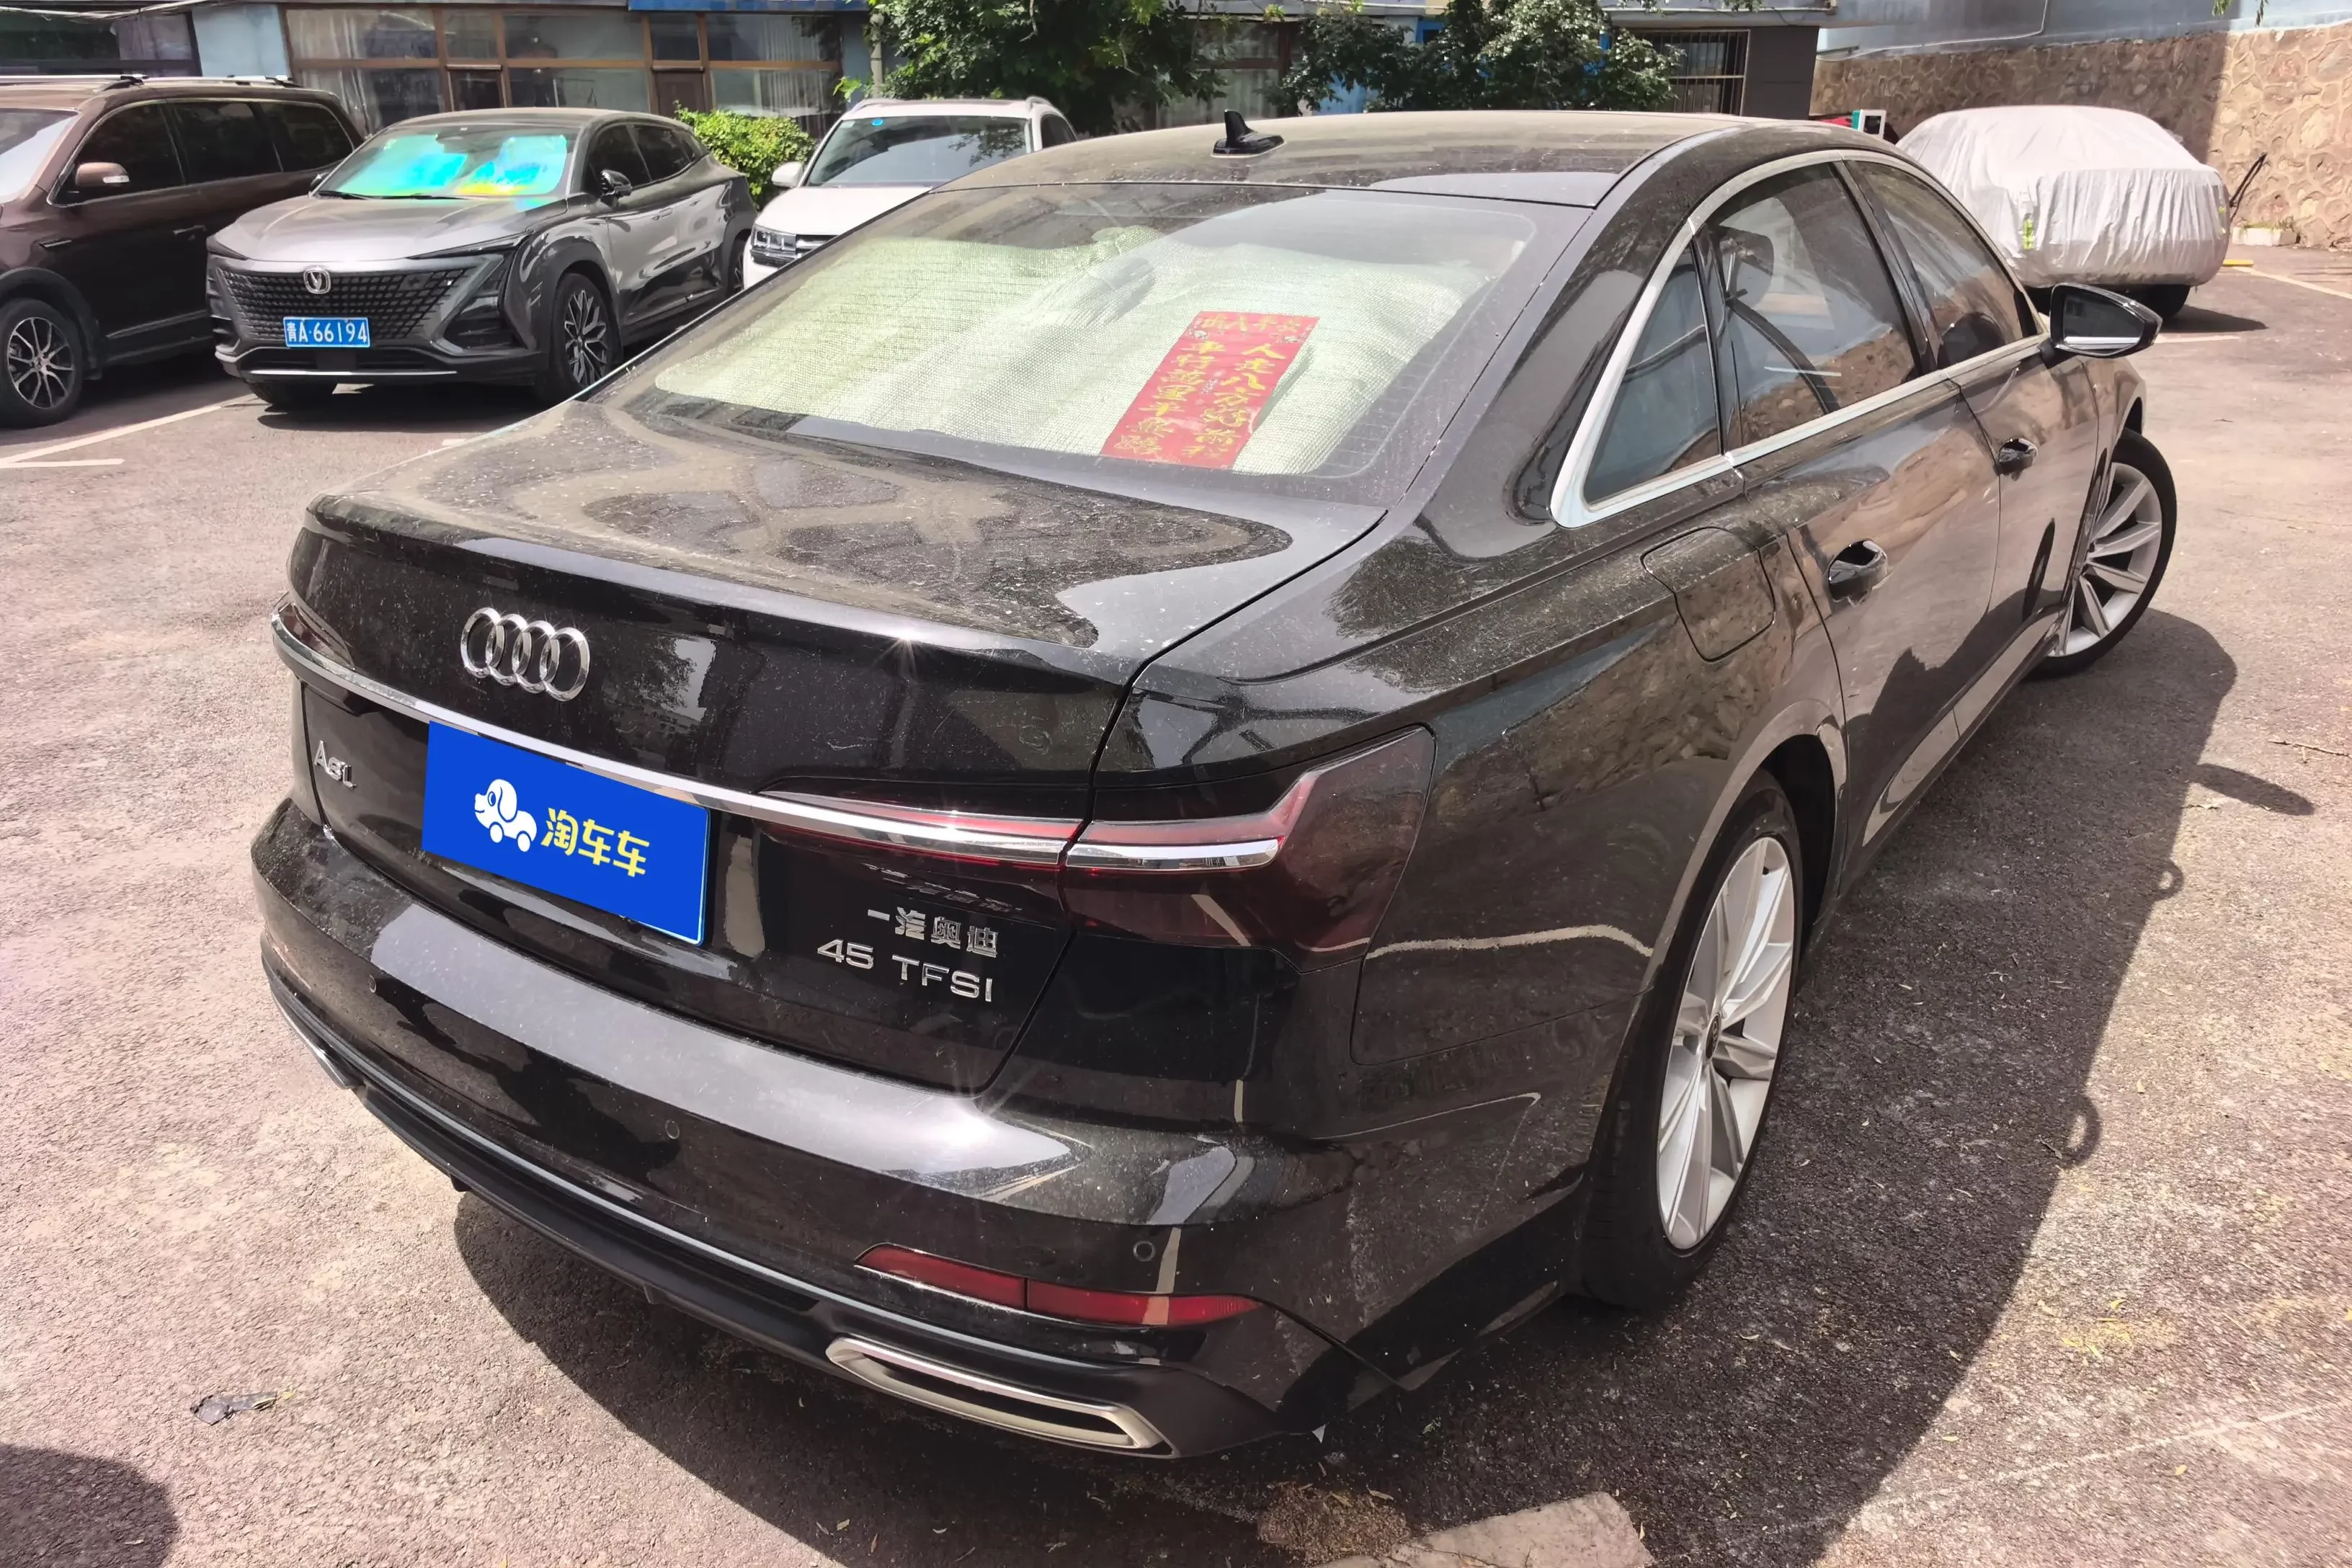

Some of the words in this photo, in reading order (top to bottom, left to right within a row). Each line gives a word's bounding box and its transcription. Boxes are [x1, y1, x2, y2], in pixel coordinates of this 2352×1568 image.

[313, 740, 357, 788] A6L
[867, 906, 999, 958] 一汽奥迪
[816, 938, 874, 970] 45
[891, 954, 994, 1002] TFSI
